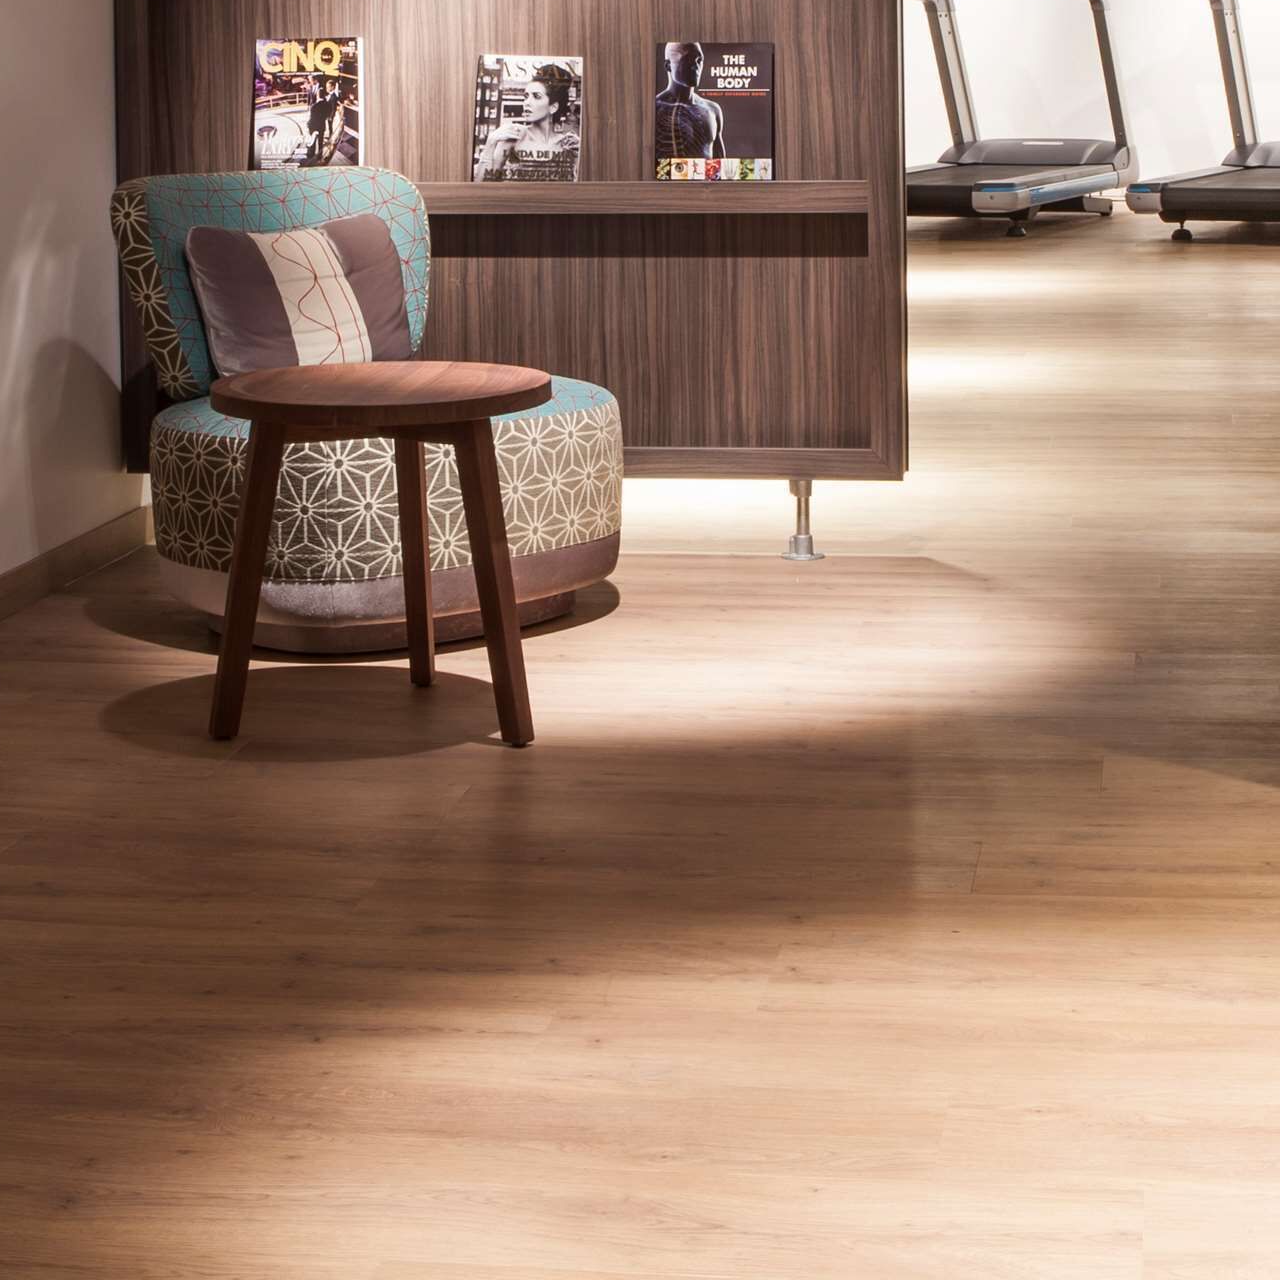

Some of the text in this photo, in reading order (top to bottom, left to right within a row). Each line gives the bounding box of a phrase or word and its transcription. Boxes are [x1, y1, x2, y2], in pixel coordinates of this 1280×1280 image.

[260, 40, 341, 77] CINQ
[722, 54, 746, 65] THE
[710, 66, 758, 77] HUMAN
[717, 78, 751, 89] BODY
[536, 149, 551, 159] DE
